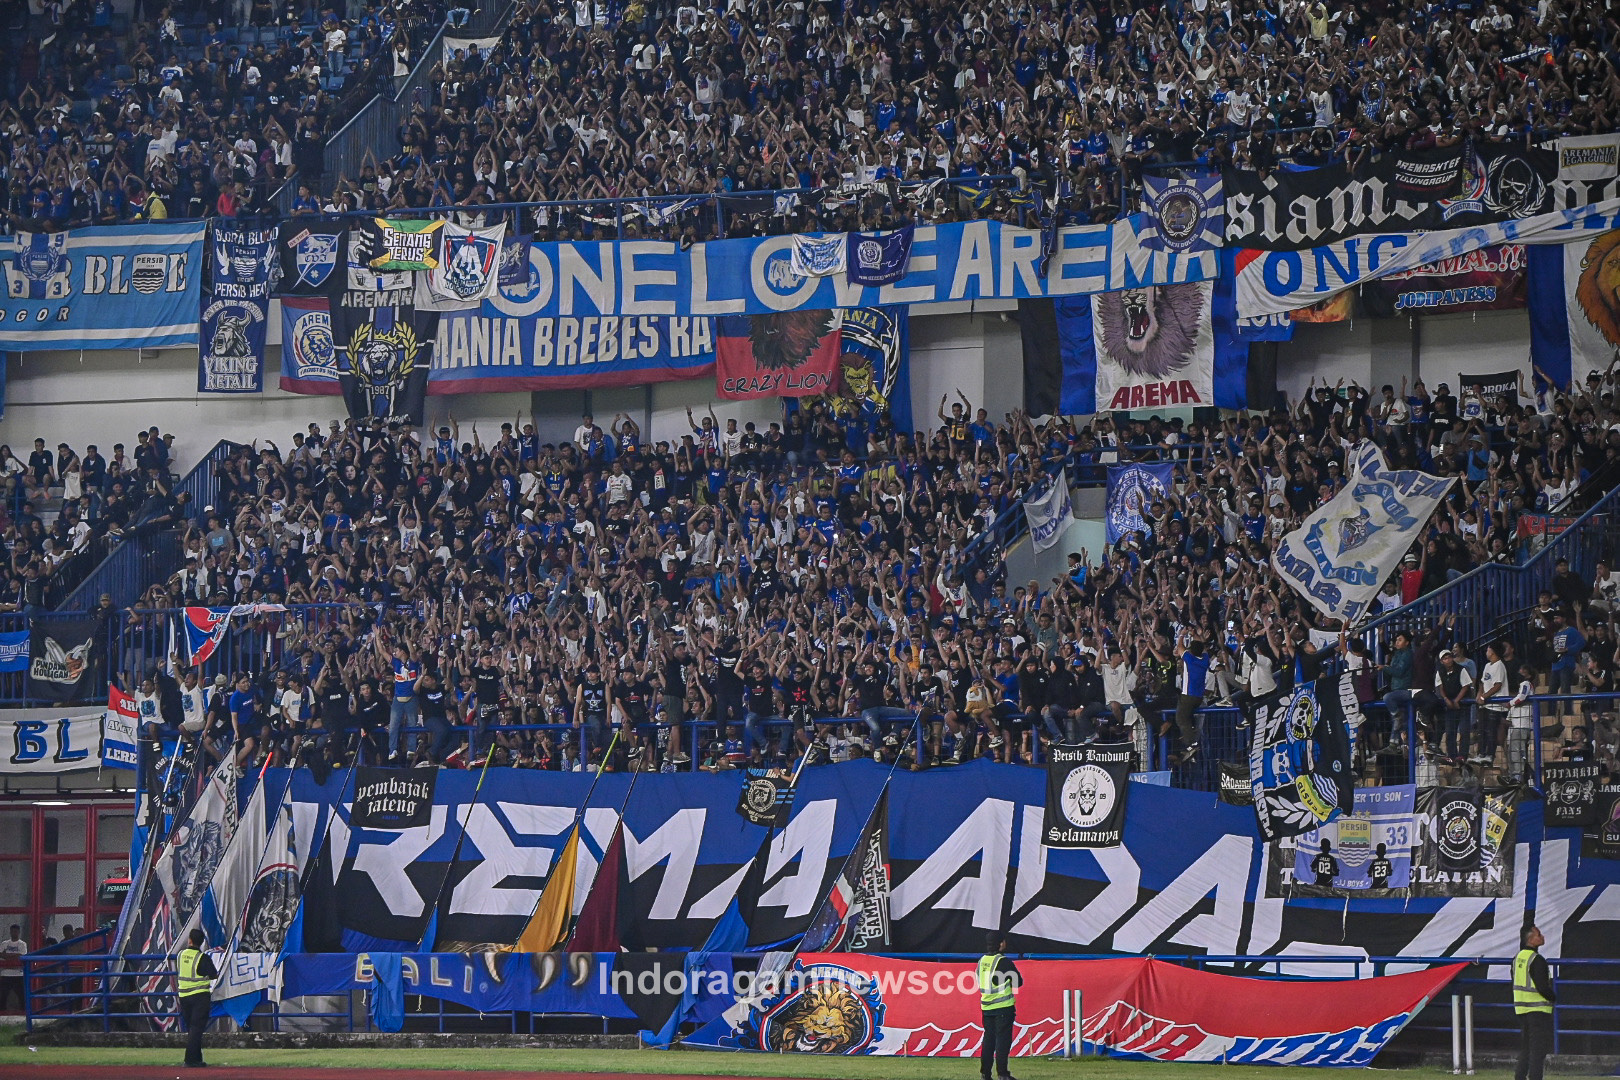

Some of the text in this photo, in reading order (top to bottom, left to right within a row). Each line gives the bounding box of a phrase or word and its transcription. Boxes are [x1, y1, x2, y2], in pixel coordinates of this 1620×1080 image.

[215, 228, 244, 246] BLORA
[136, 256, 164, 264] PERSIB
[13, 280, 63, 295] 3 3
[215, 283, 246, 298] PERSIB
[1394, 286, 1497, 310] JODIPANESS
[533, 317, 660, 367] BREBES
[203, 355, 258, 375] VIKING
[204, 373, 257, 392] RETAIL
[371, 385, 390, 395] 1987
[722, 370, 834, 394] CRAZY LION
[1109, 379, 1202, 410] AREMA
[1250, 704, 1269, 780] BANDUNG
[1053, 749, 1131, 762] Persib Bandung
[356, 777, 429, 803] pembajak
[1370, 793, 1380, 803] TO
[1384, 791, 1401, 803] SON
[366, 796, 417, 817] jateng
[1048, 826, 1119, 844] Selamanya
[1340, 822, 1368, 831] PERSIB
[1385, 826, 1408, 847] 33
[1318, 862, 1331, 875] 02
[1374, 865, 1387, 878] 23
[1346, 880, 1364, 888] BOYS
